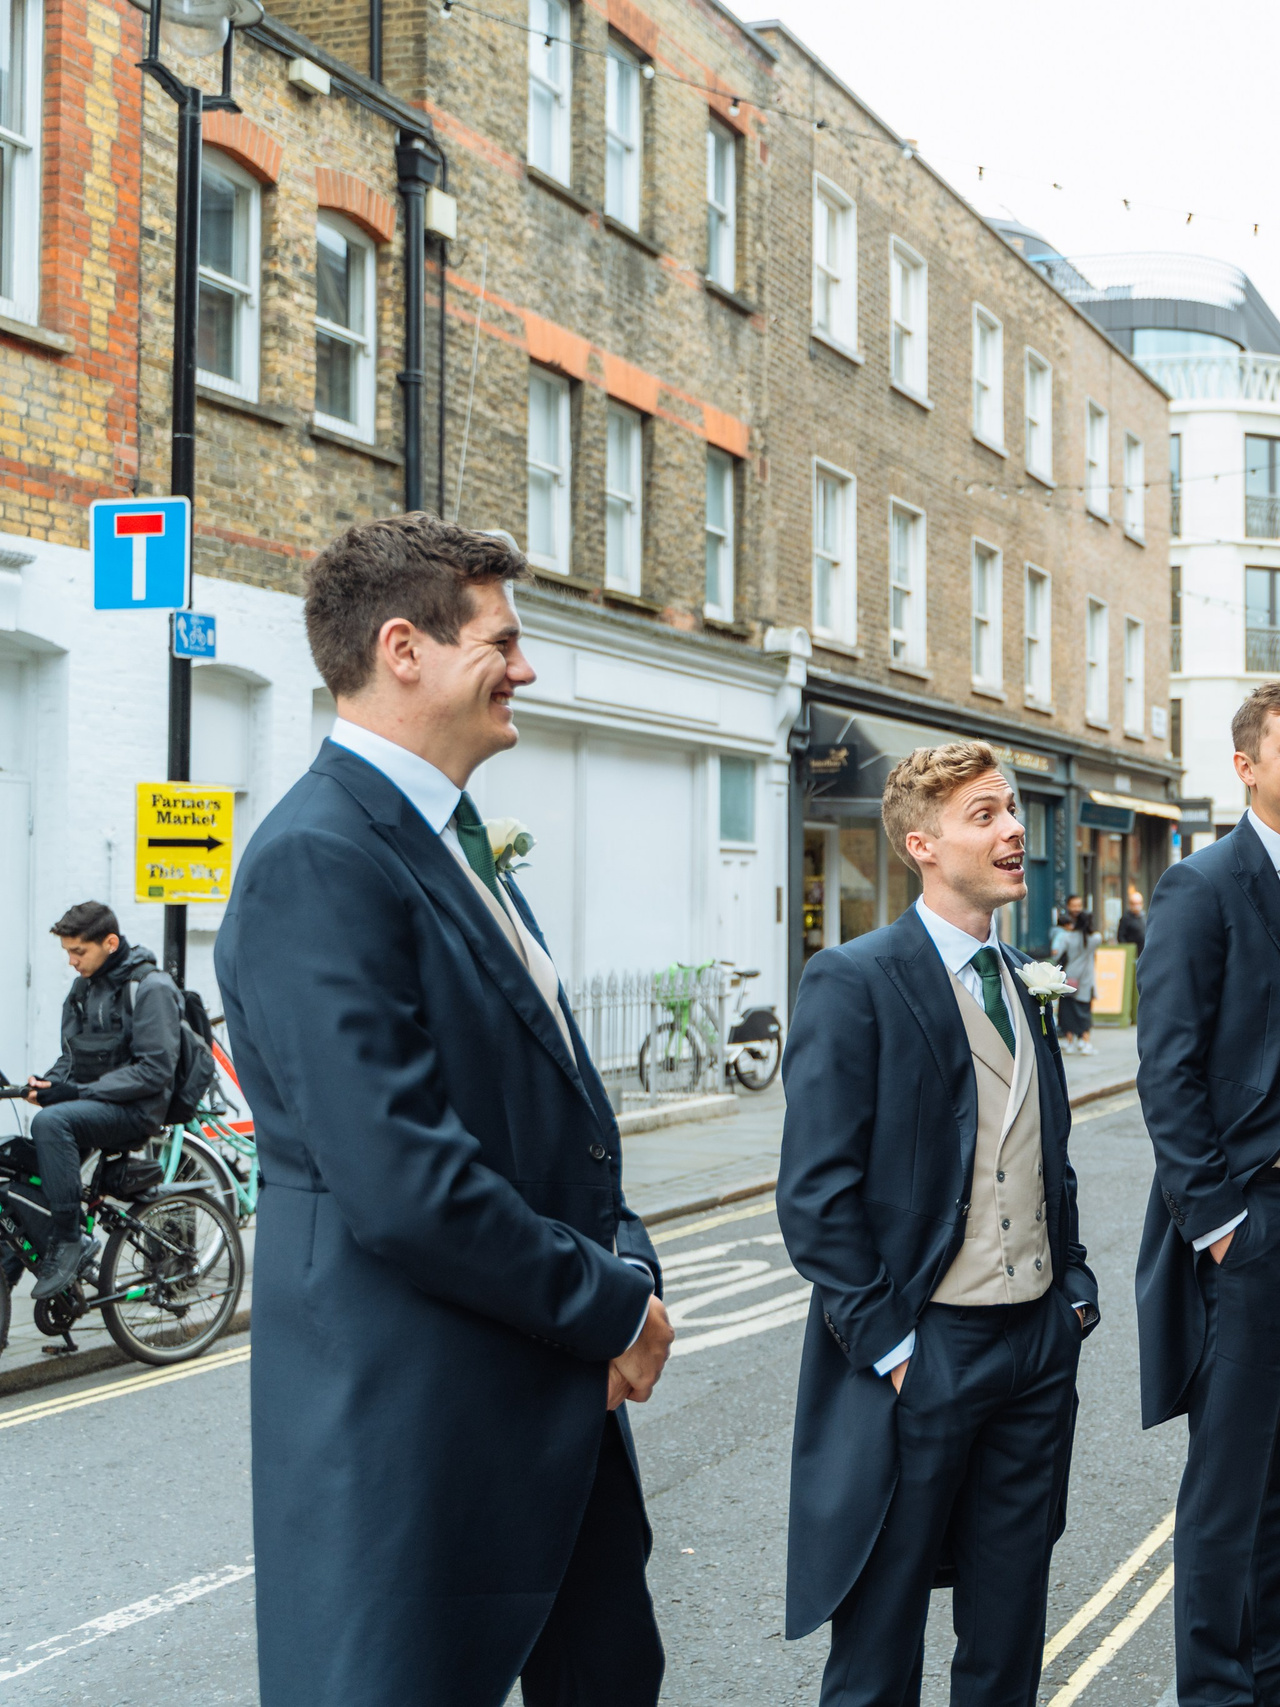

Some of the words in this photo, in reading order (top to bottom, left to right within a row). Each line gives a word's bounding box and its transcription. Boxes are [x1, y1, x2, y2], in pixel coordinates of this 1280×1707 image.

[151, 793, 221, 810] Farmers
[156, 810, 217, 826] Market
[147, 863, 185, 879] This
